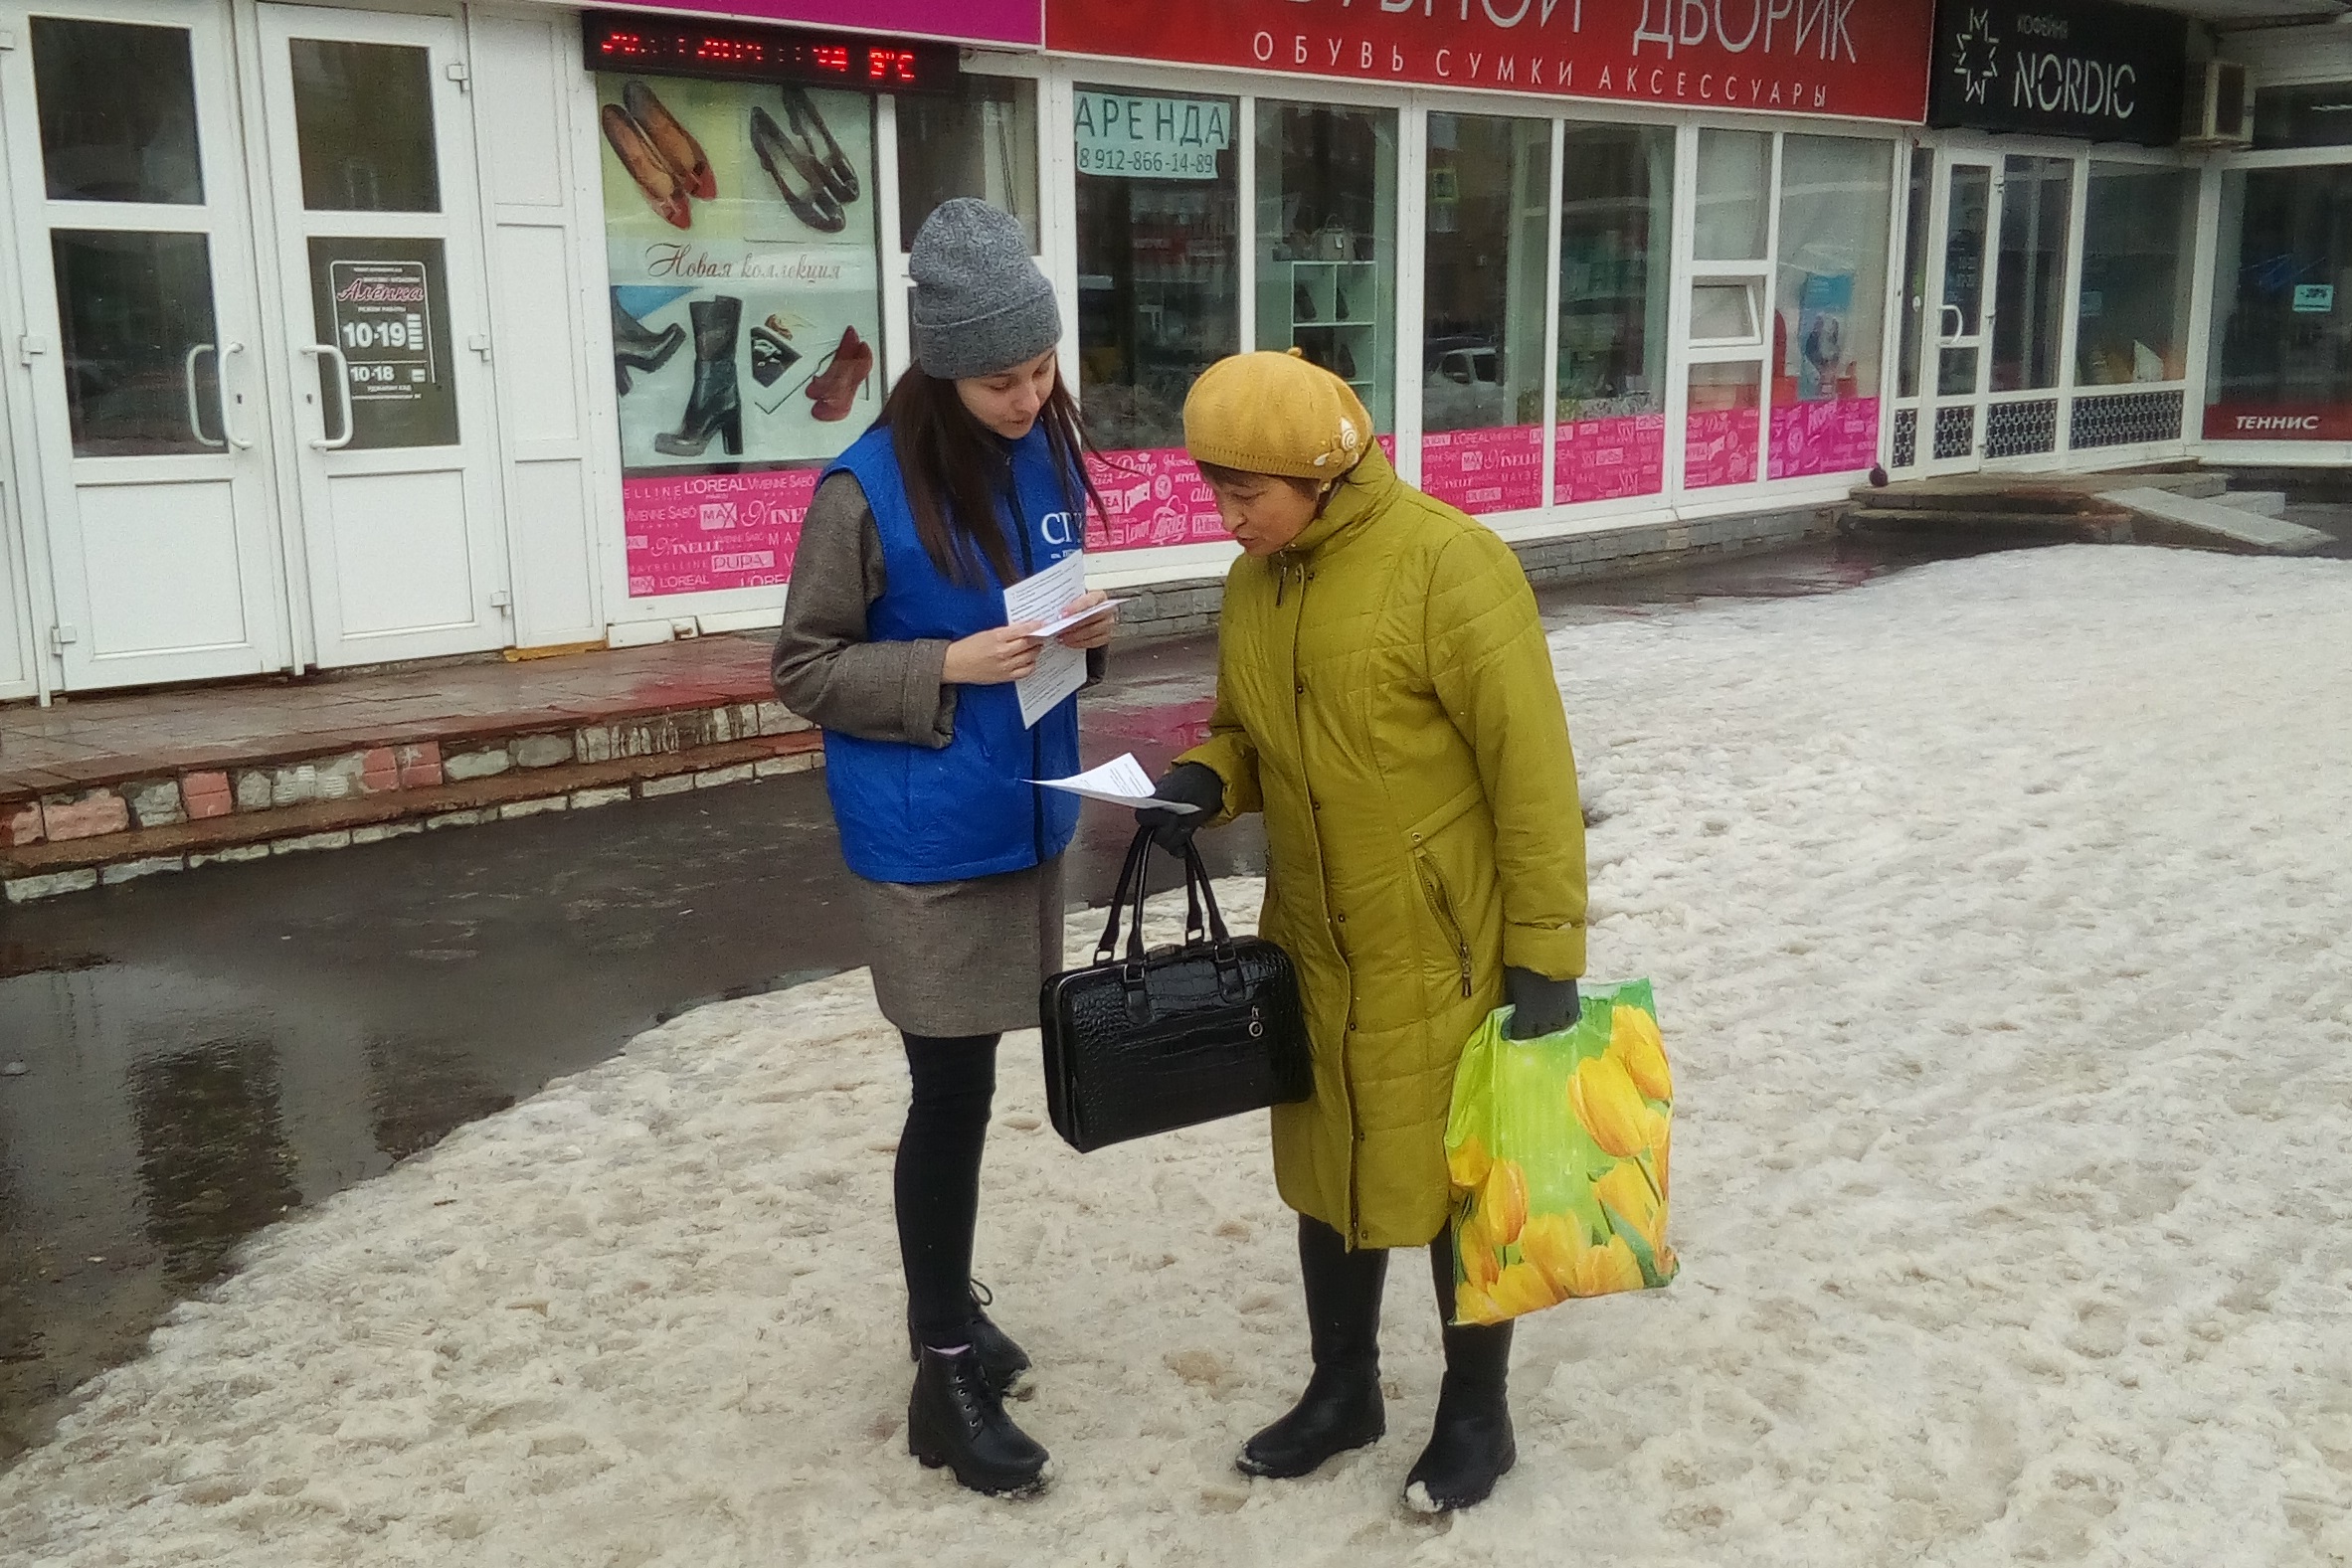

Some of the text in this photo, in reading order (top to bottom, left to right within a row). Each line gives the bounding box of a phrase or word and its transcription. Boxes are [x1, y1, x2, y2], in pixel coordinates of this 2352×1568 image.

[1253, 31, 1827, 107] ОБУВЬ СУМКИ АКСЕССУАРЫ
[2013, 51, 2136, 119] NORDIC
[1074, 96, 1224, 148] АРЕНДА
[1095, 149, 1213, 173] 912-866-14-89
[645, 243, 841, 283] Новая коллекция
[337, 278, 425, 302] Алёнка
[2236, 416, 2319, 430] ТЕННИС
[713, 555, 765, 570] PUPA
